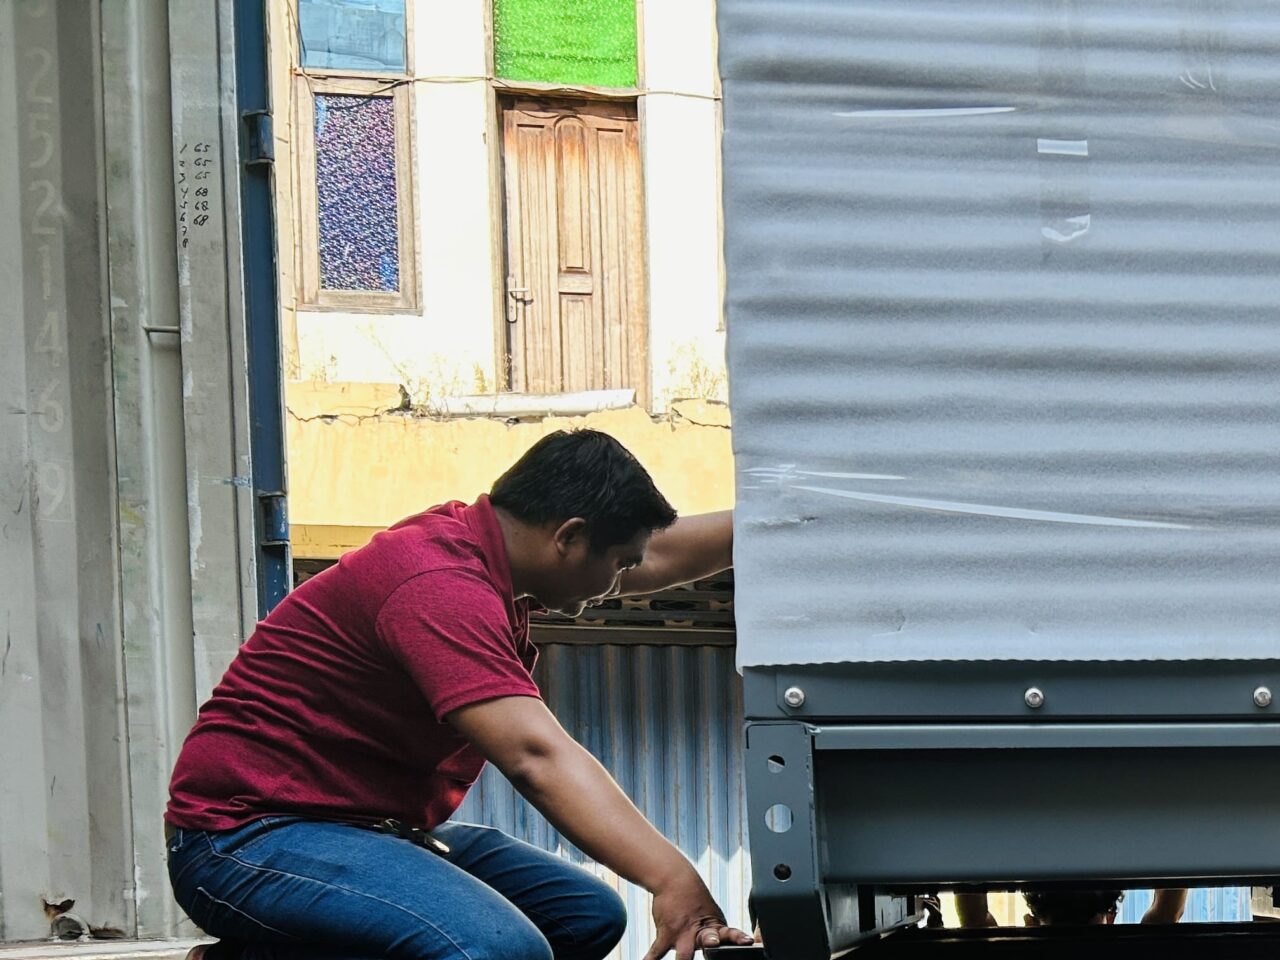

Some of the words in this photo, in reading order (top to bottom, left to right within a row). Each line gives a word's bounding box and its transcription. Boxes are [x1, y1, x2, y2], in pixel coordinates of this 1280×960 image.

[193, 143, 211, 152] 65
[194, 158, 212, 166] 65
[195, 187, 209, 197] 68
[193, 214, 209, 226] 68
